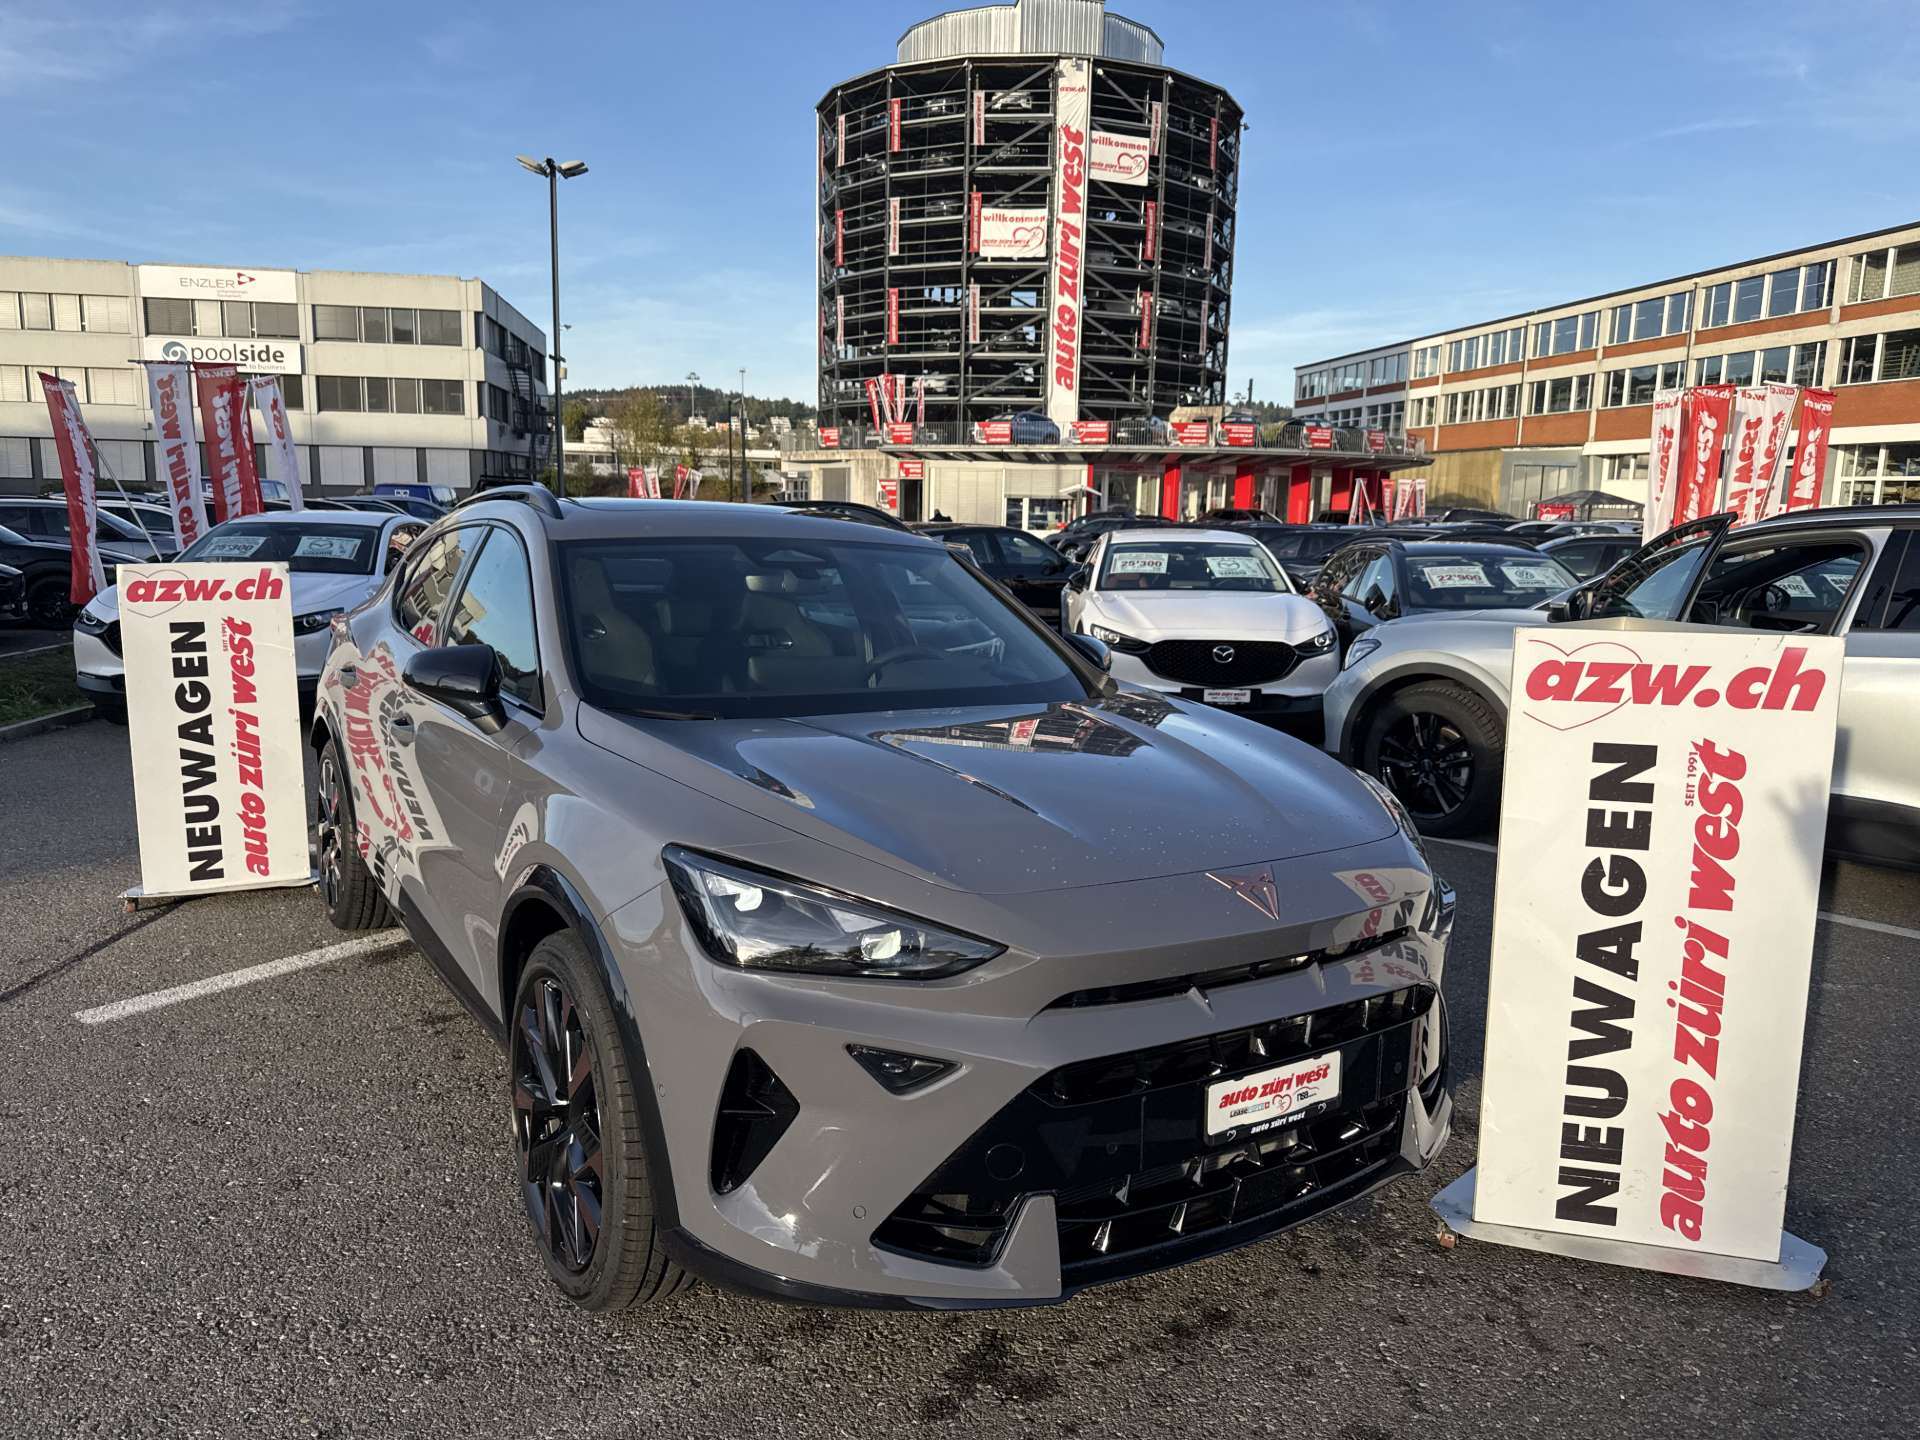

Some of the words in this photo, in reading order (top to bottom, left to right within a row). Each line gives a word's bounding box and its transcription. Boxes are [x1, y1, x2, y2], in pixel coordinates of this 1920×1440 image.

[1060, 124, 1084, 213] west
[179, 278, 235, 289] ENZLER
[1056, 216, 1081, 303] züri
[191, 343, 285, 364] poolside
[1053, 304, 1077, 391] auto
[126, 568, 283, 603] azw.ch
[221, 616, 257, 704] west
[1525, 647, 1826, 712] azw.ch
[169, 621, 225, 882] NEUWAGEN
[228, 708, 264, 791] züri
[1686, 751, 1699, 777] 1991
[236, 792, 270, 876] auto
[1684, 779, 1696, 807] SEIT
[1688, 738, 1748, 912] west
[1555, 742, 1659, 1227] NEUWAGEN
[1667, 916, 1730, 1081] züri
[1219, 1085, 1258, 1109] auto
[1259, 1073, 1295, 1098] züri
[1296, 1064, 1330, 1087] west
[1250, 1123, 1269, 1134] auto
[1270, 1117, 1288, 1129] züri
[1288, 1111, 1306, 1122] west
[1658, 1078, 1715, 1242] auto
